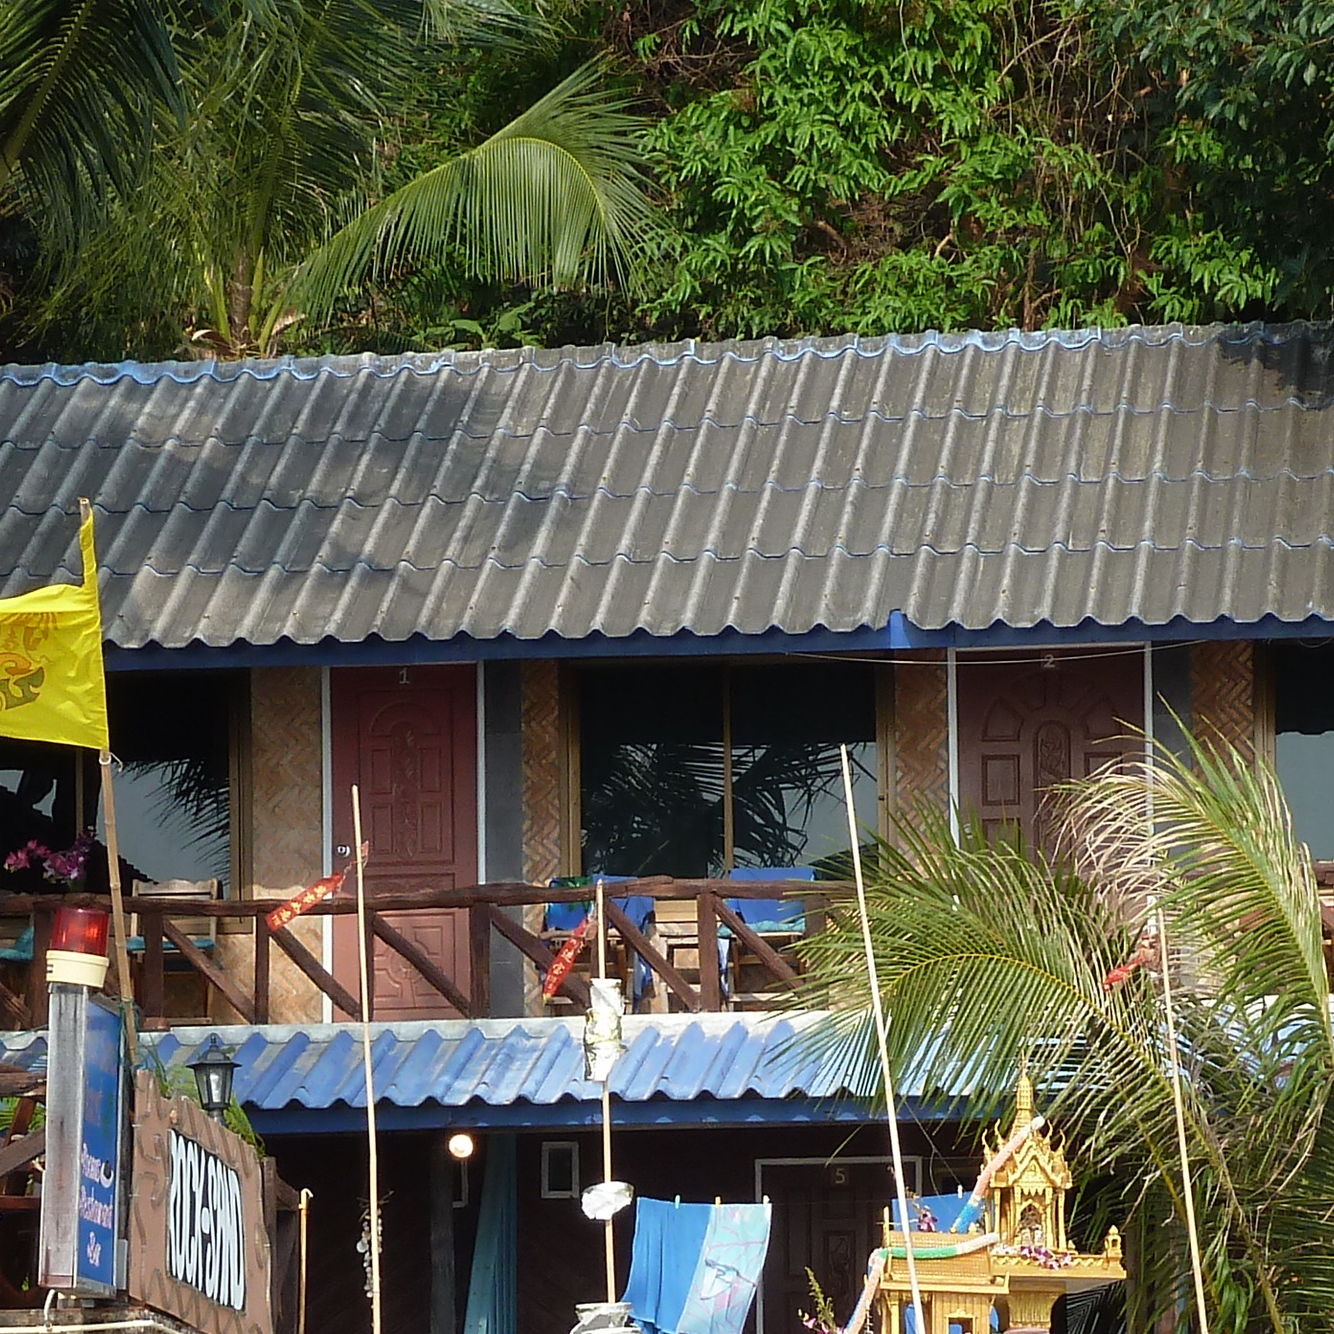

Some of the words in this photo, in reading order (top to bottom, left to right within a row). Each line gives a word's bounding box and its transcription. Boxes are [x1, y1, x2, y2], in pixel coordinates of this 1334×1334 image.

[1043, 653, 1056, 668] 2
[398, 667, 411, 685] 1
[835, 1167, 846, 1184] 5
